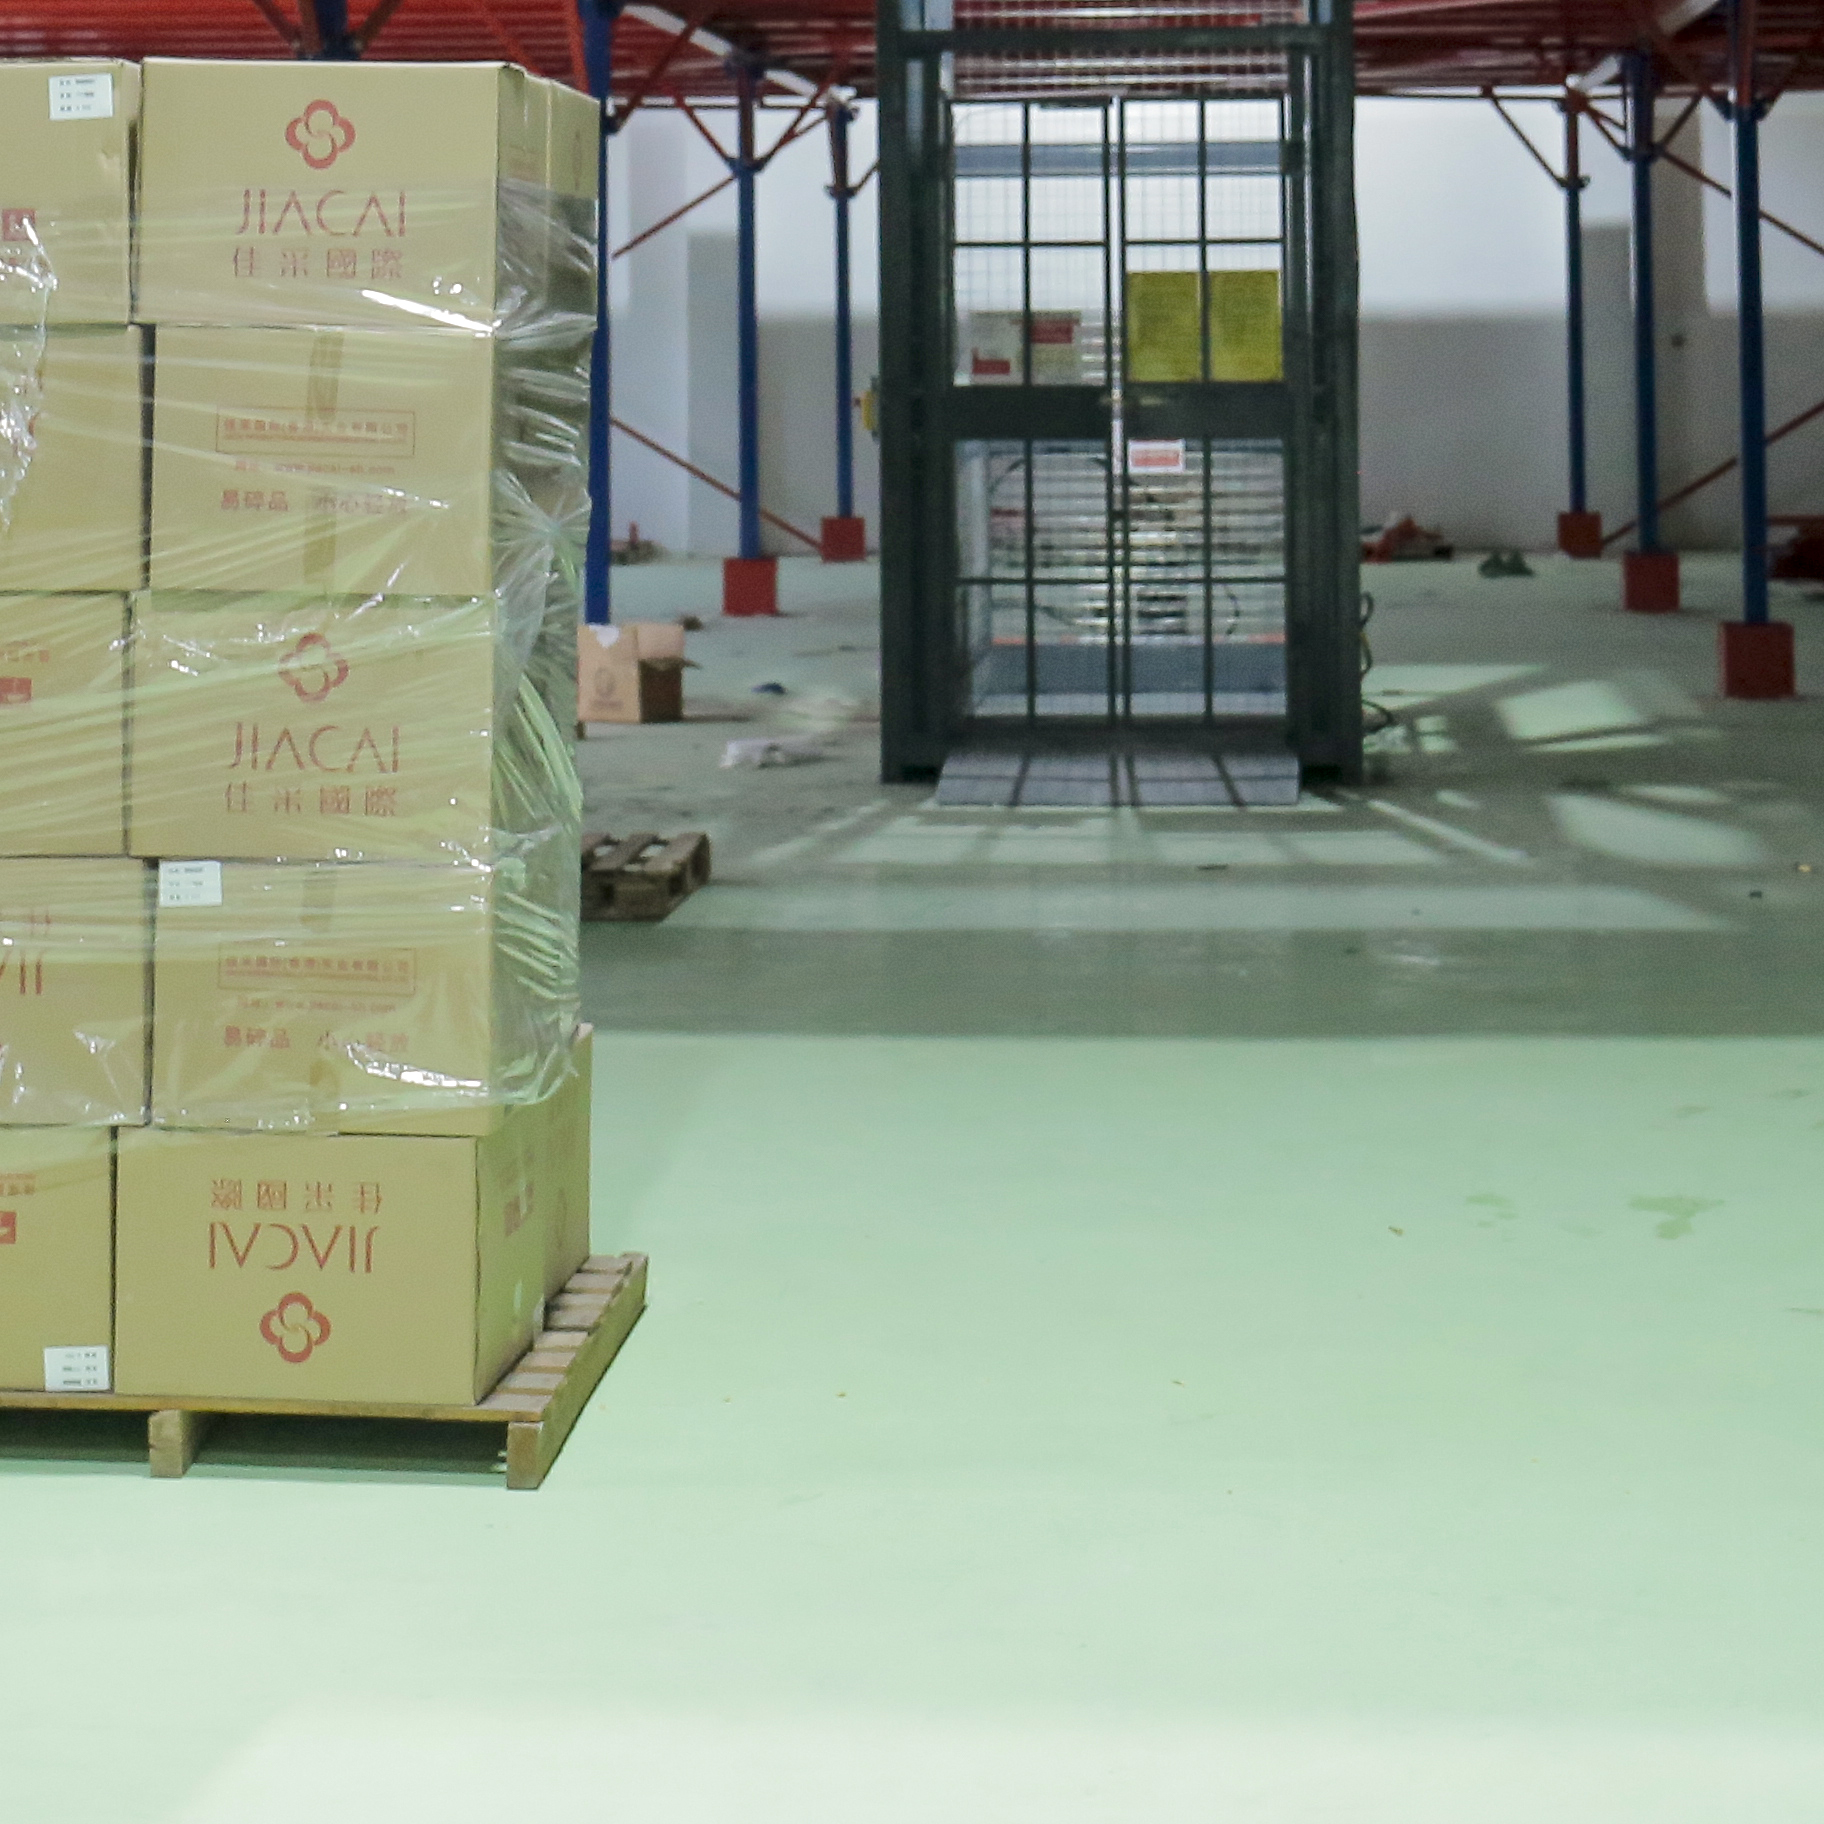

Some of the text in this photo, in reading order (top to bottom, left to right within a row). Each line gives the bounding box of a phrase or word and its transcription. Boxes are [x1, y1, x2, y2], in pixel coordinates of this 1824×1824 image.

[235, 189, 406, 237] JIACAI
[228, 722, 400, 774] JIACAI
[209, 1222, 379, 1273] JIACAI
